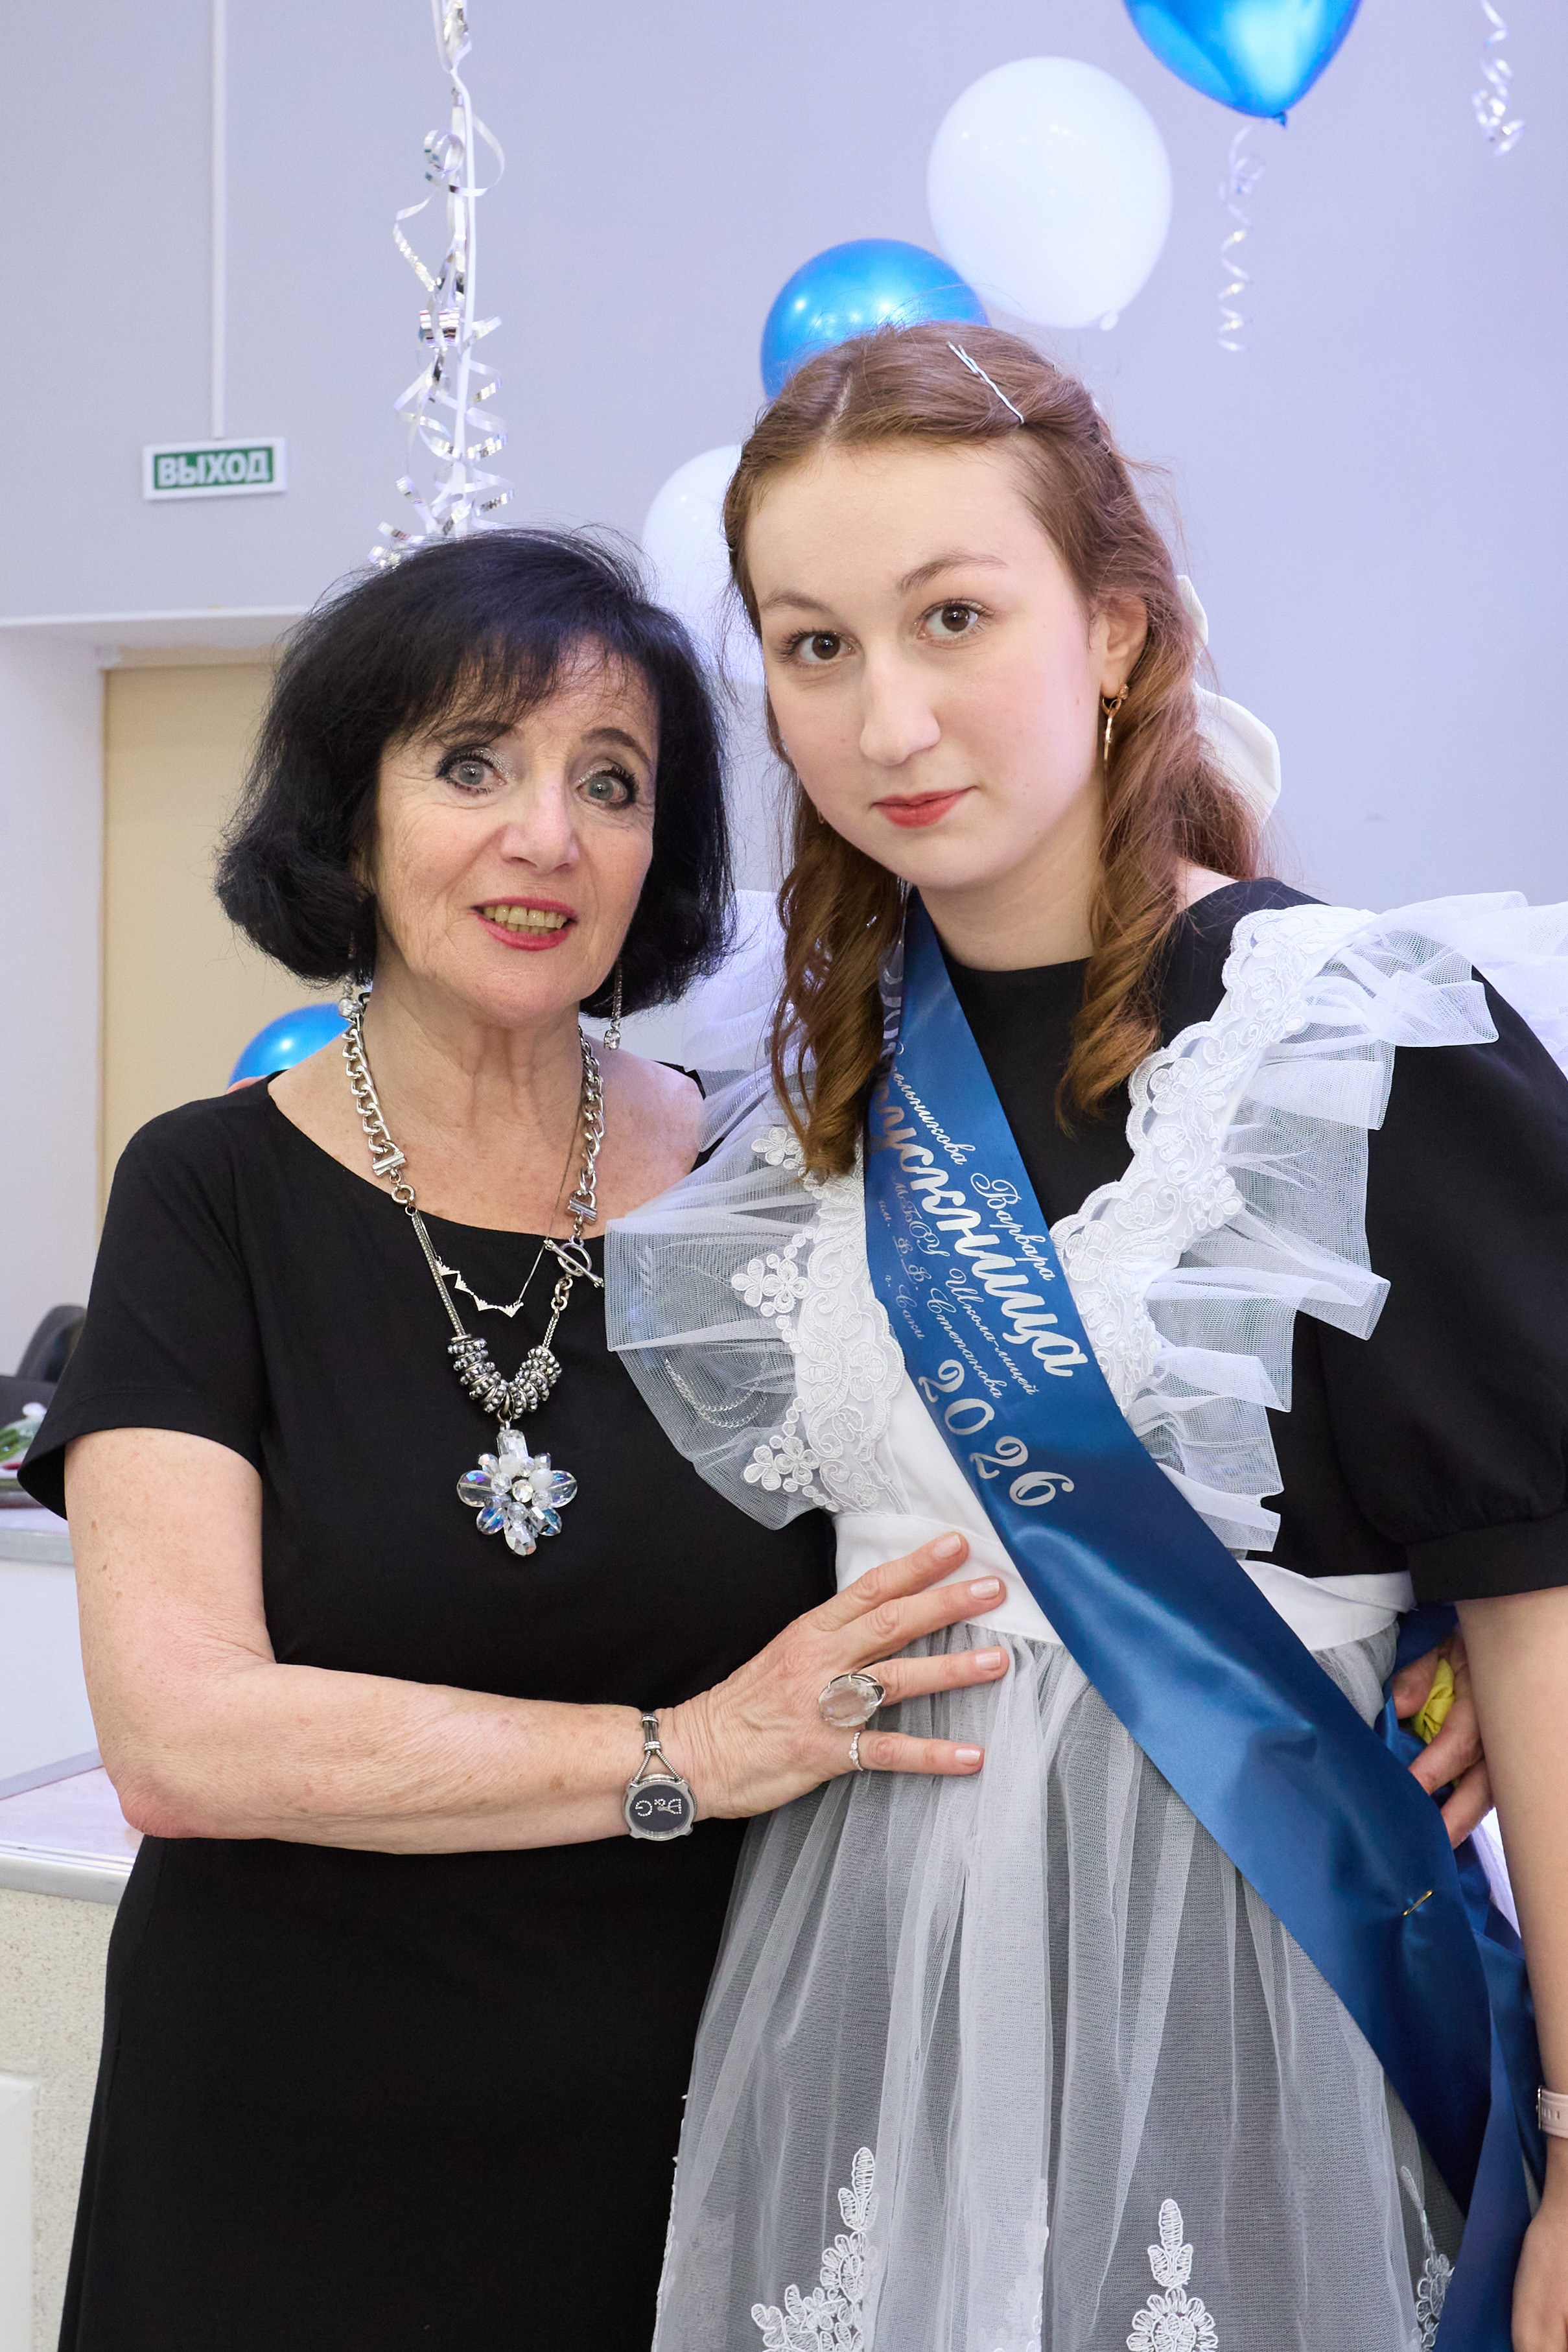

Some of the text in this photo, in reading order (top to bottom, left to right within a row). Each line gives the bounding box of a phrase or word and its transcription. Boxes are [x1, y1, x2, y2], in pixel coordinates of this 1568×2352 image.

[158, 451, 270, 486] ВЫХОД
[970, 1172, 1056, 1281] Варвара
[896, 1284, 925, 1340] Саки
[927, 1288, 1007, 1399] Степанова
[945, 1267, 1040, 1395] Школа-лицей
[918, 1359, 1075, 1507] 2026
